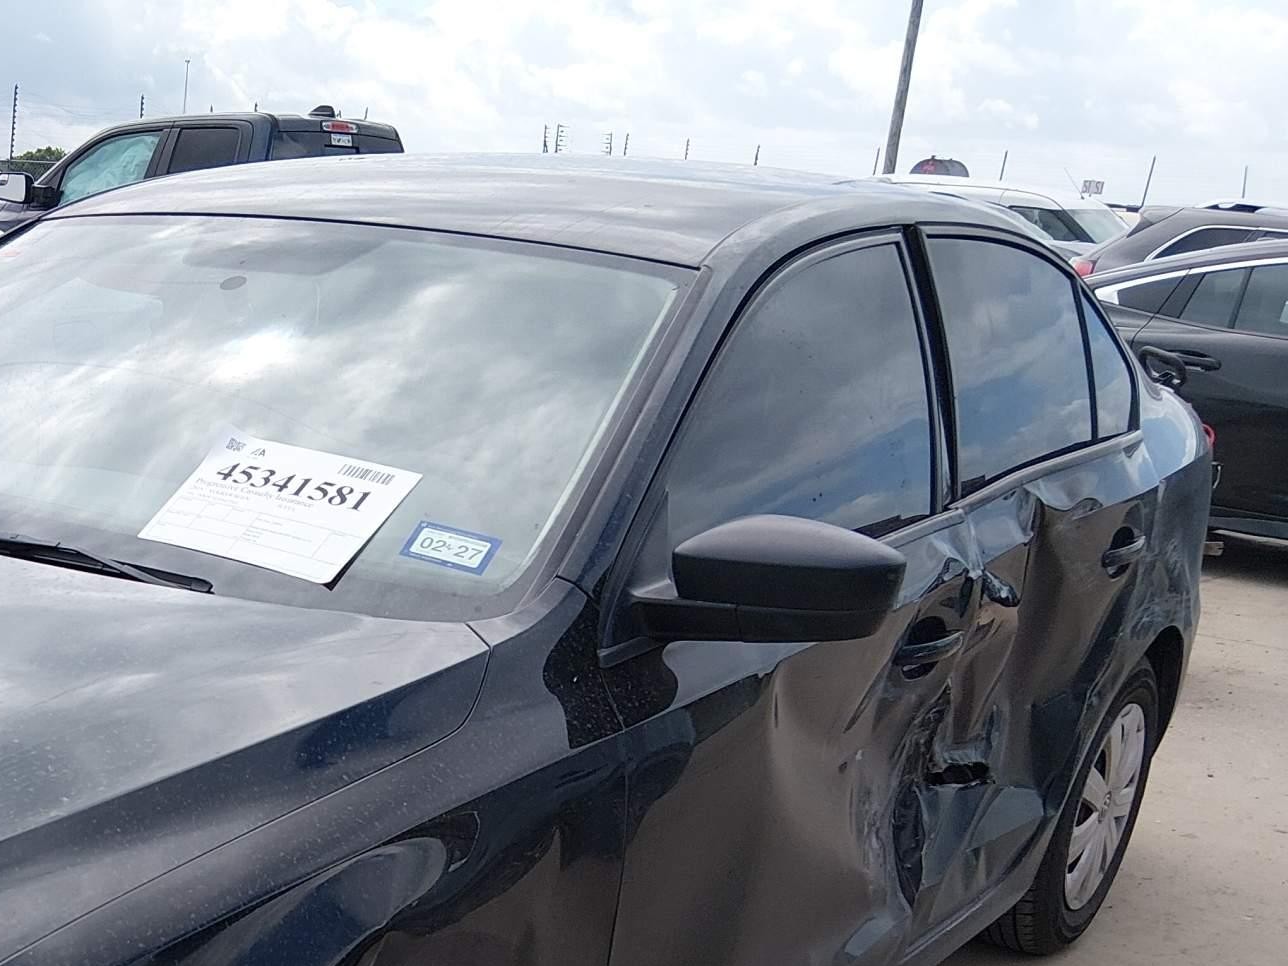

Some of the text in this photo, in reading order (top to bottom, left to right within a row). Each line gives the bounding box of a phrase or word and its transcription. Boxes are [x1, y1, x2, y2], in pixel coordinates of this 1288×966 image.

[216, 462, 372, 512] 45341581
[420, 536, 447, 552] 02
[454, 545, 484, 560] 27
